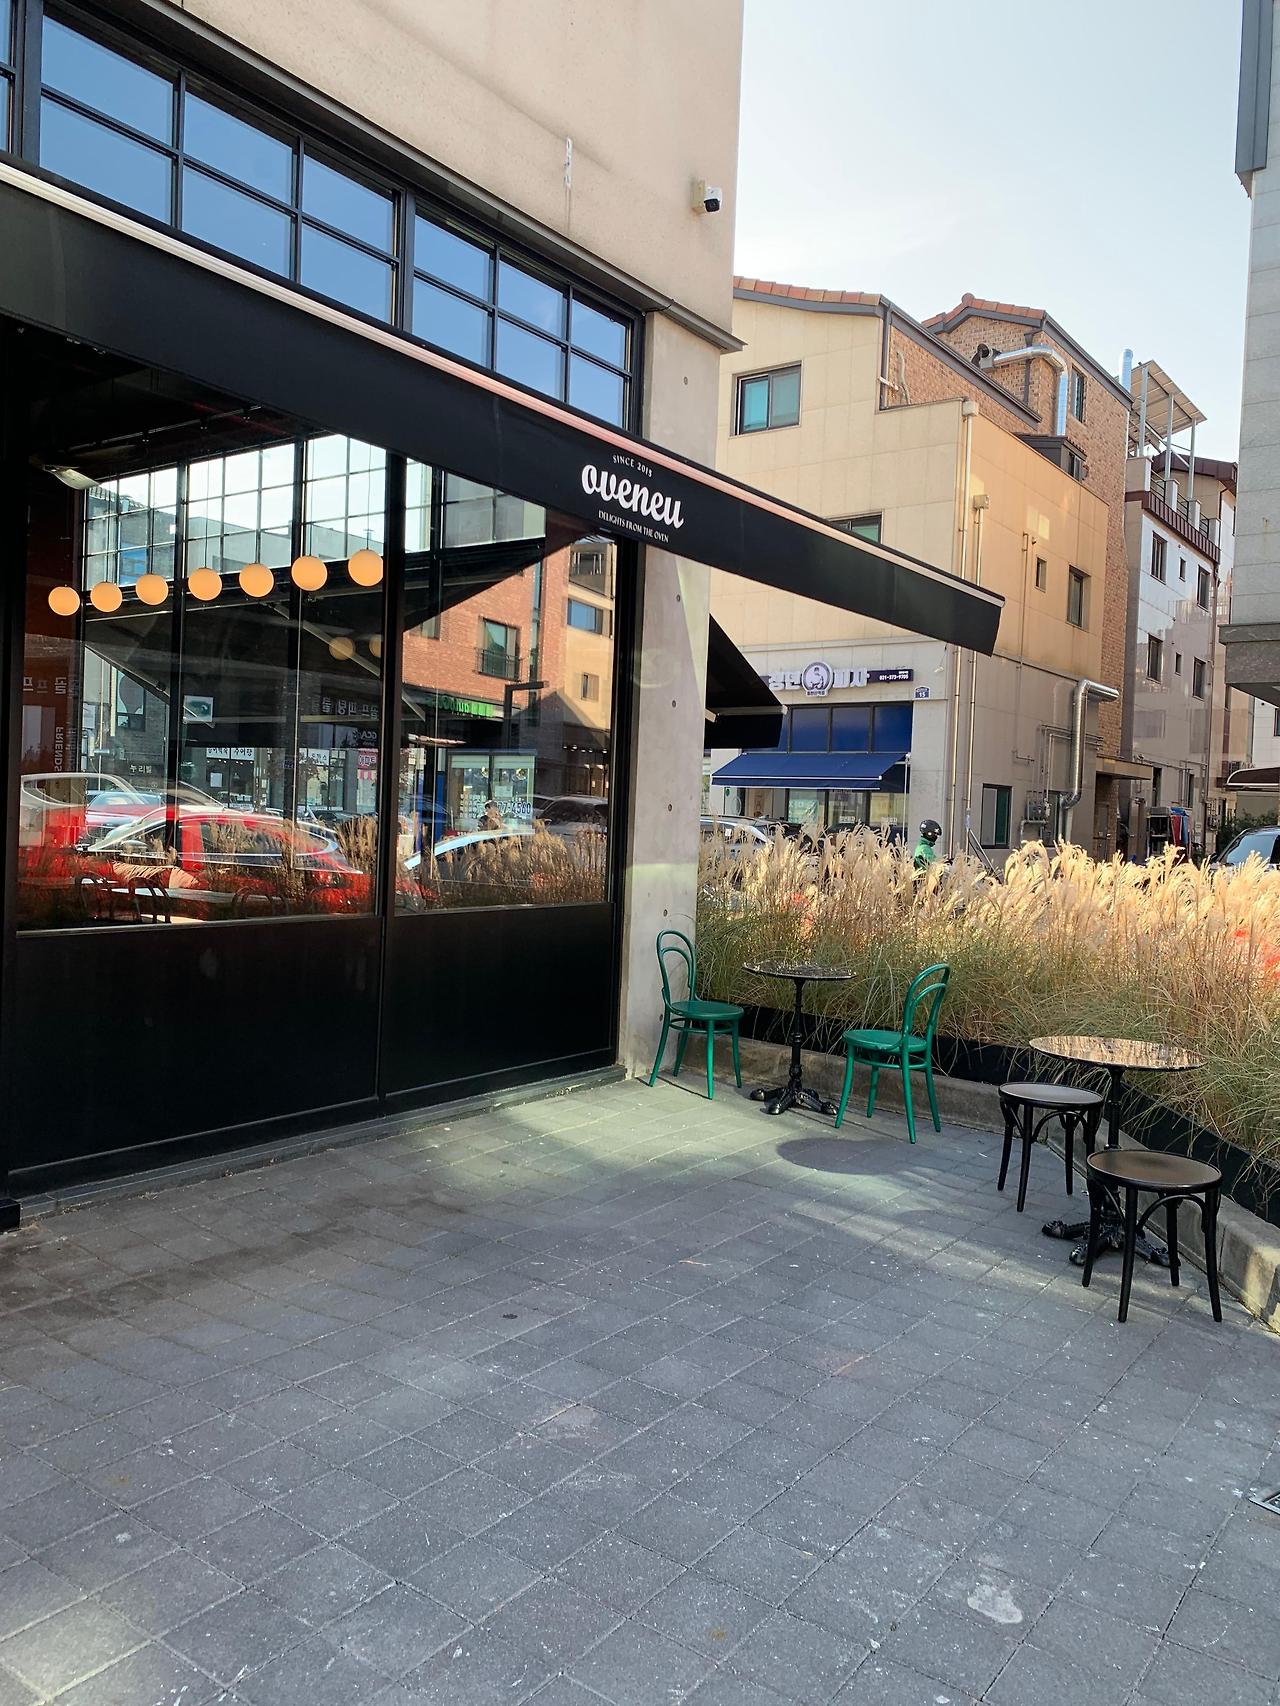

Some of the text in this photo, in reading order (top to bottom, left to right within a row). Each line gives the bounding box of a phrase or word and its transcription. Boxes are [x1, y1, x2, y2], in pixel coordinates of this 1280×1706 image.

[612, 454, 635, 468] SINCE
[581, 464, 684, 529] oveneu
[598, 510, 669, 543] DELIGHTS FROM THE OVEN
